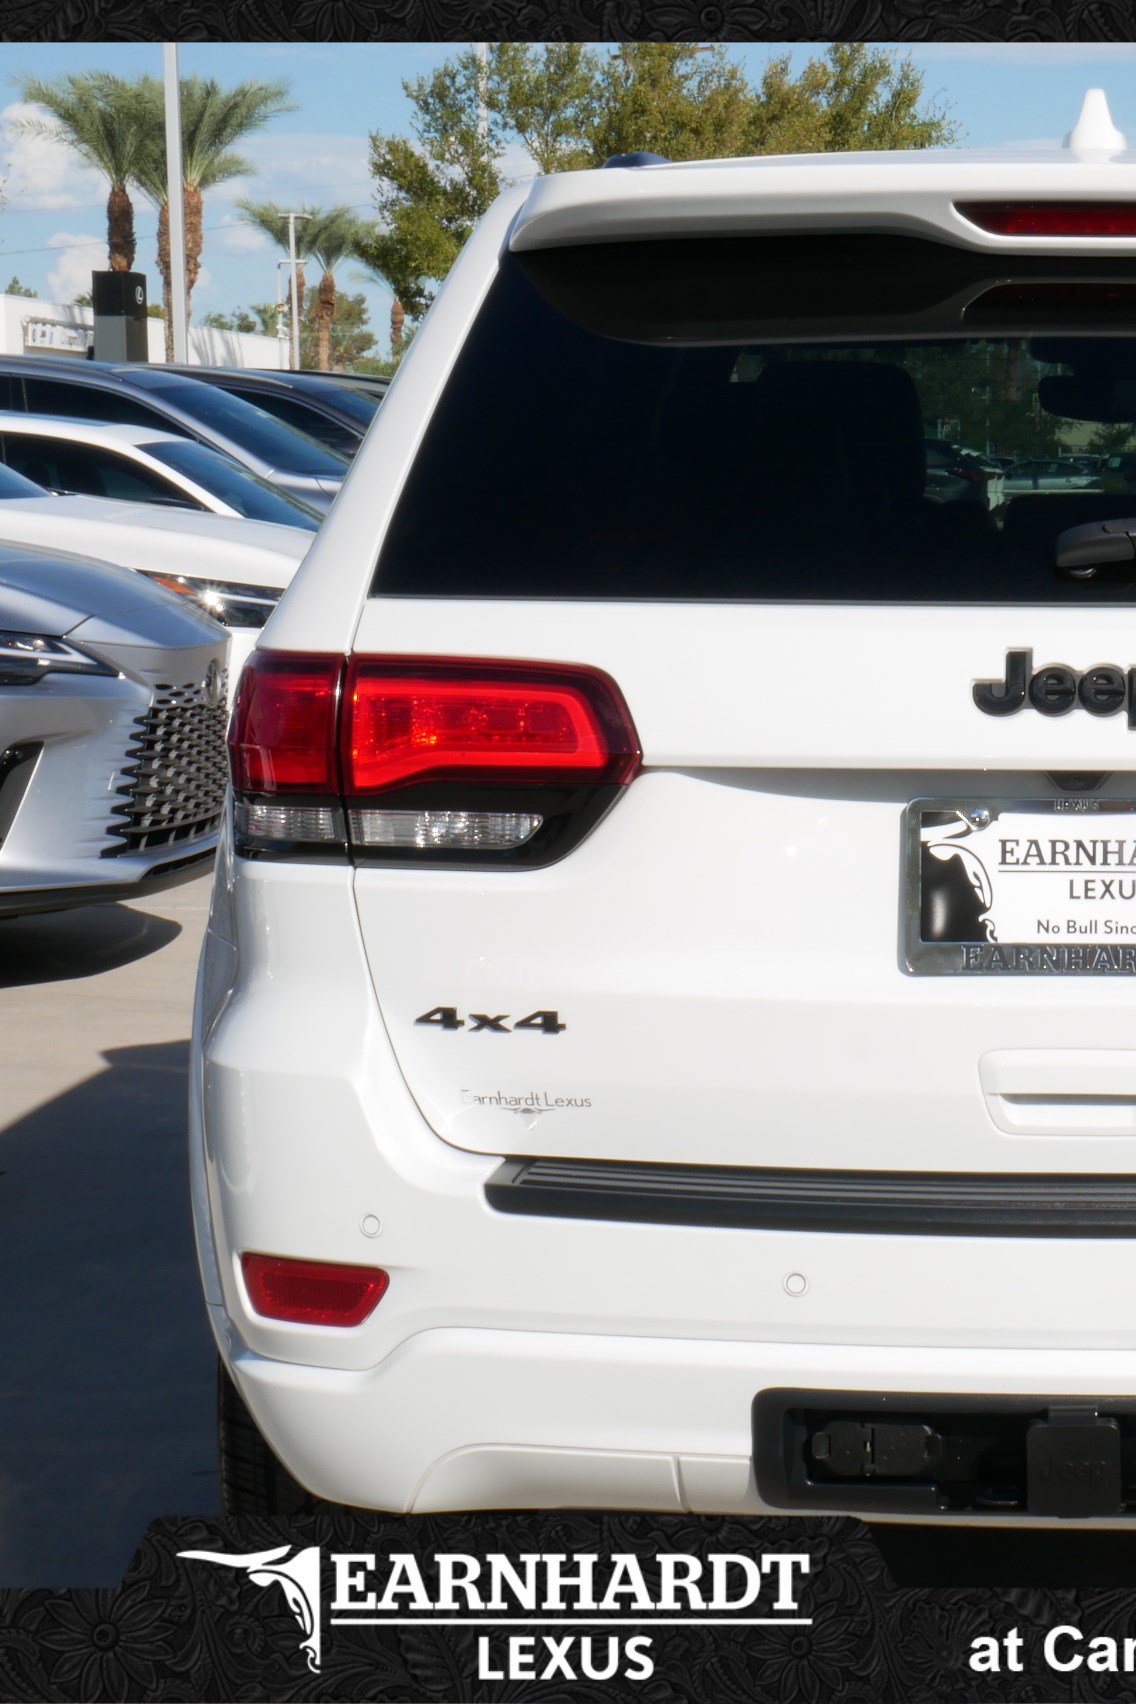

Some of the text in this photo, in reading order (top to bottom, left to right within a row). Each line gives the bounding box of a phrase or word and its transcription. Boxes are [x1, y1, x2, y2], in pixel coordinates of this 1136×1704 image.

[1036, 919, 1061, 935] No
[1066, 919, 1099, 935] Bull
[414, 1006, 567, 1034] 4x4
[545, 1091, 592, 1108] Lexus
